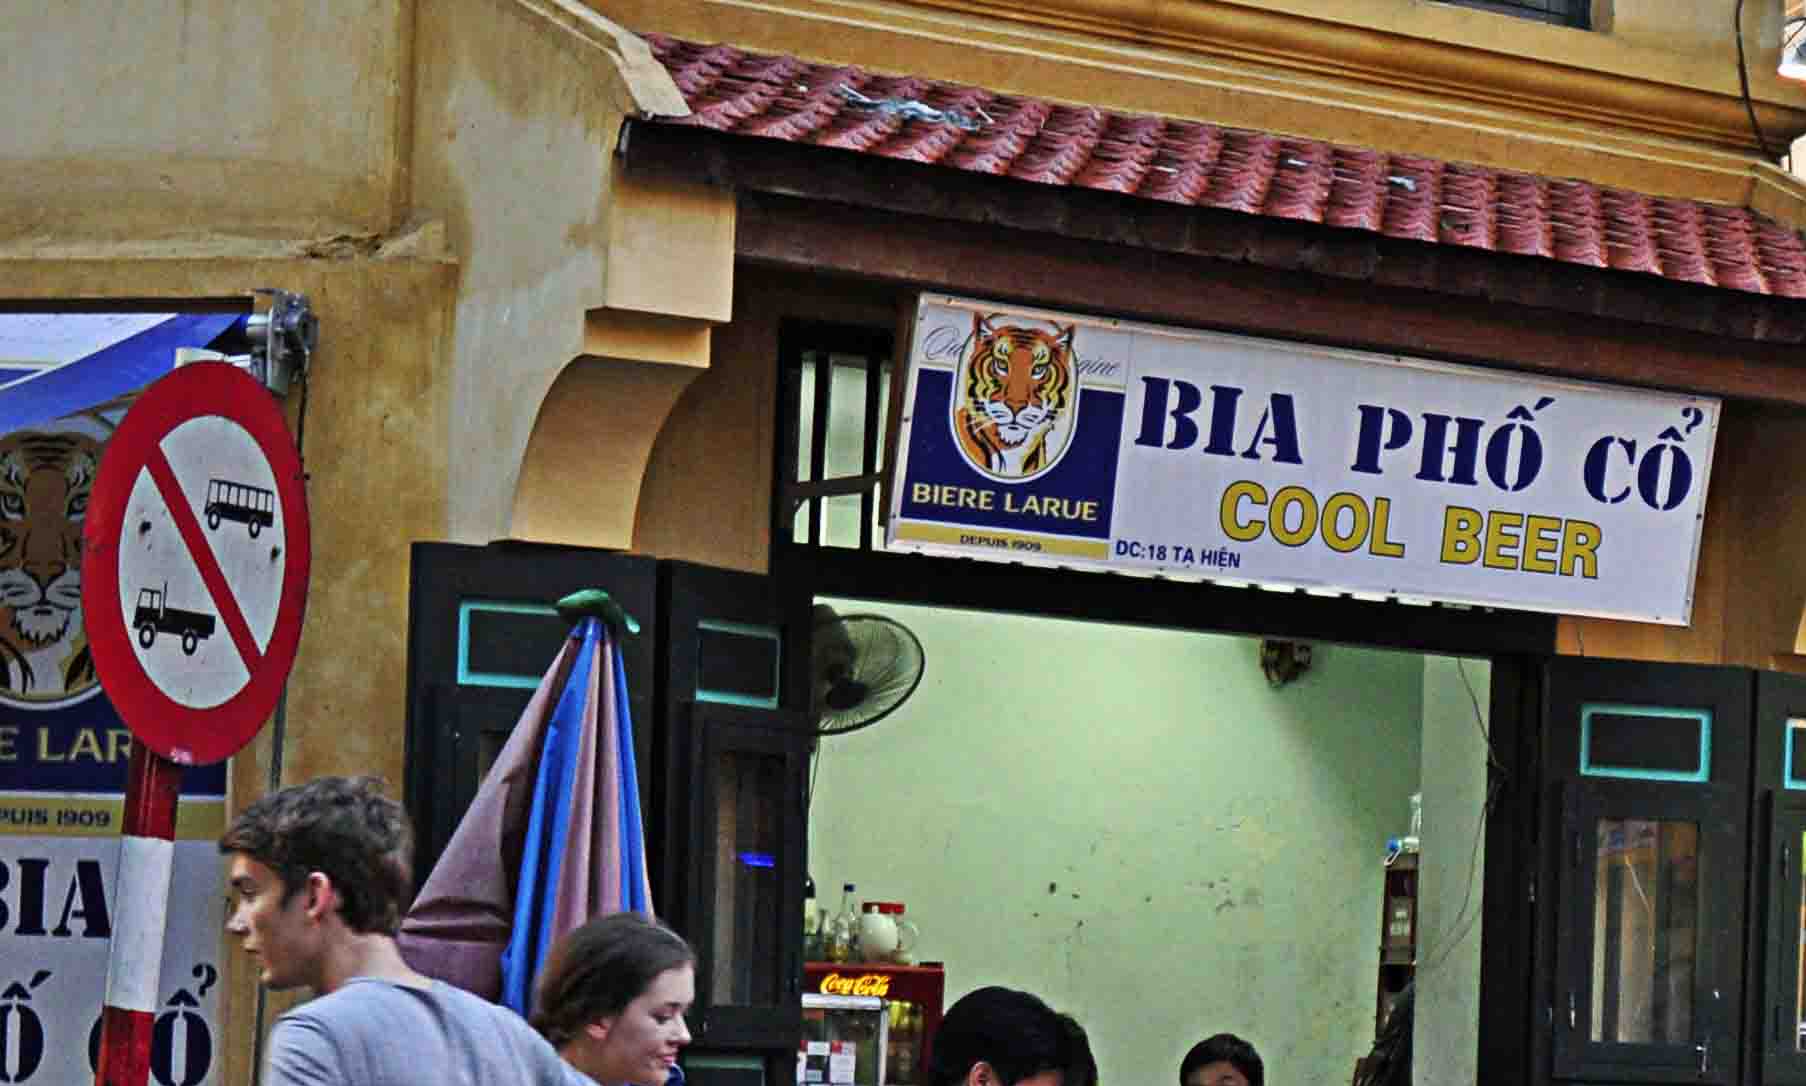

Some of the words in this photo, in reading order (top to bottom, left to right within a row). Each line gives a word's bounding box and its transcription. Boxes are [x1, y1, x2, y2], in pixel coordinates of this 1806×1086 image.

[1135, 376, 1303, 465] BIA
[1350, 396, 1555, 492] PHỐ
[1583, 407, 1704, 511] CỔ
[912, 483, 995, 510] BIERE
[1005, 492, 1099, 521] LARUE
[1219, 480, 1405, 559] COOL
[1440, 505, 1602, 580] BEER
[57, 809, 111, 827] 1909
